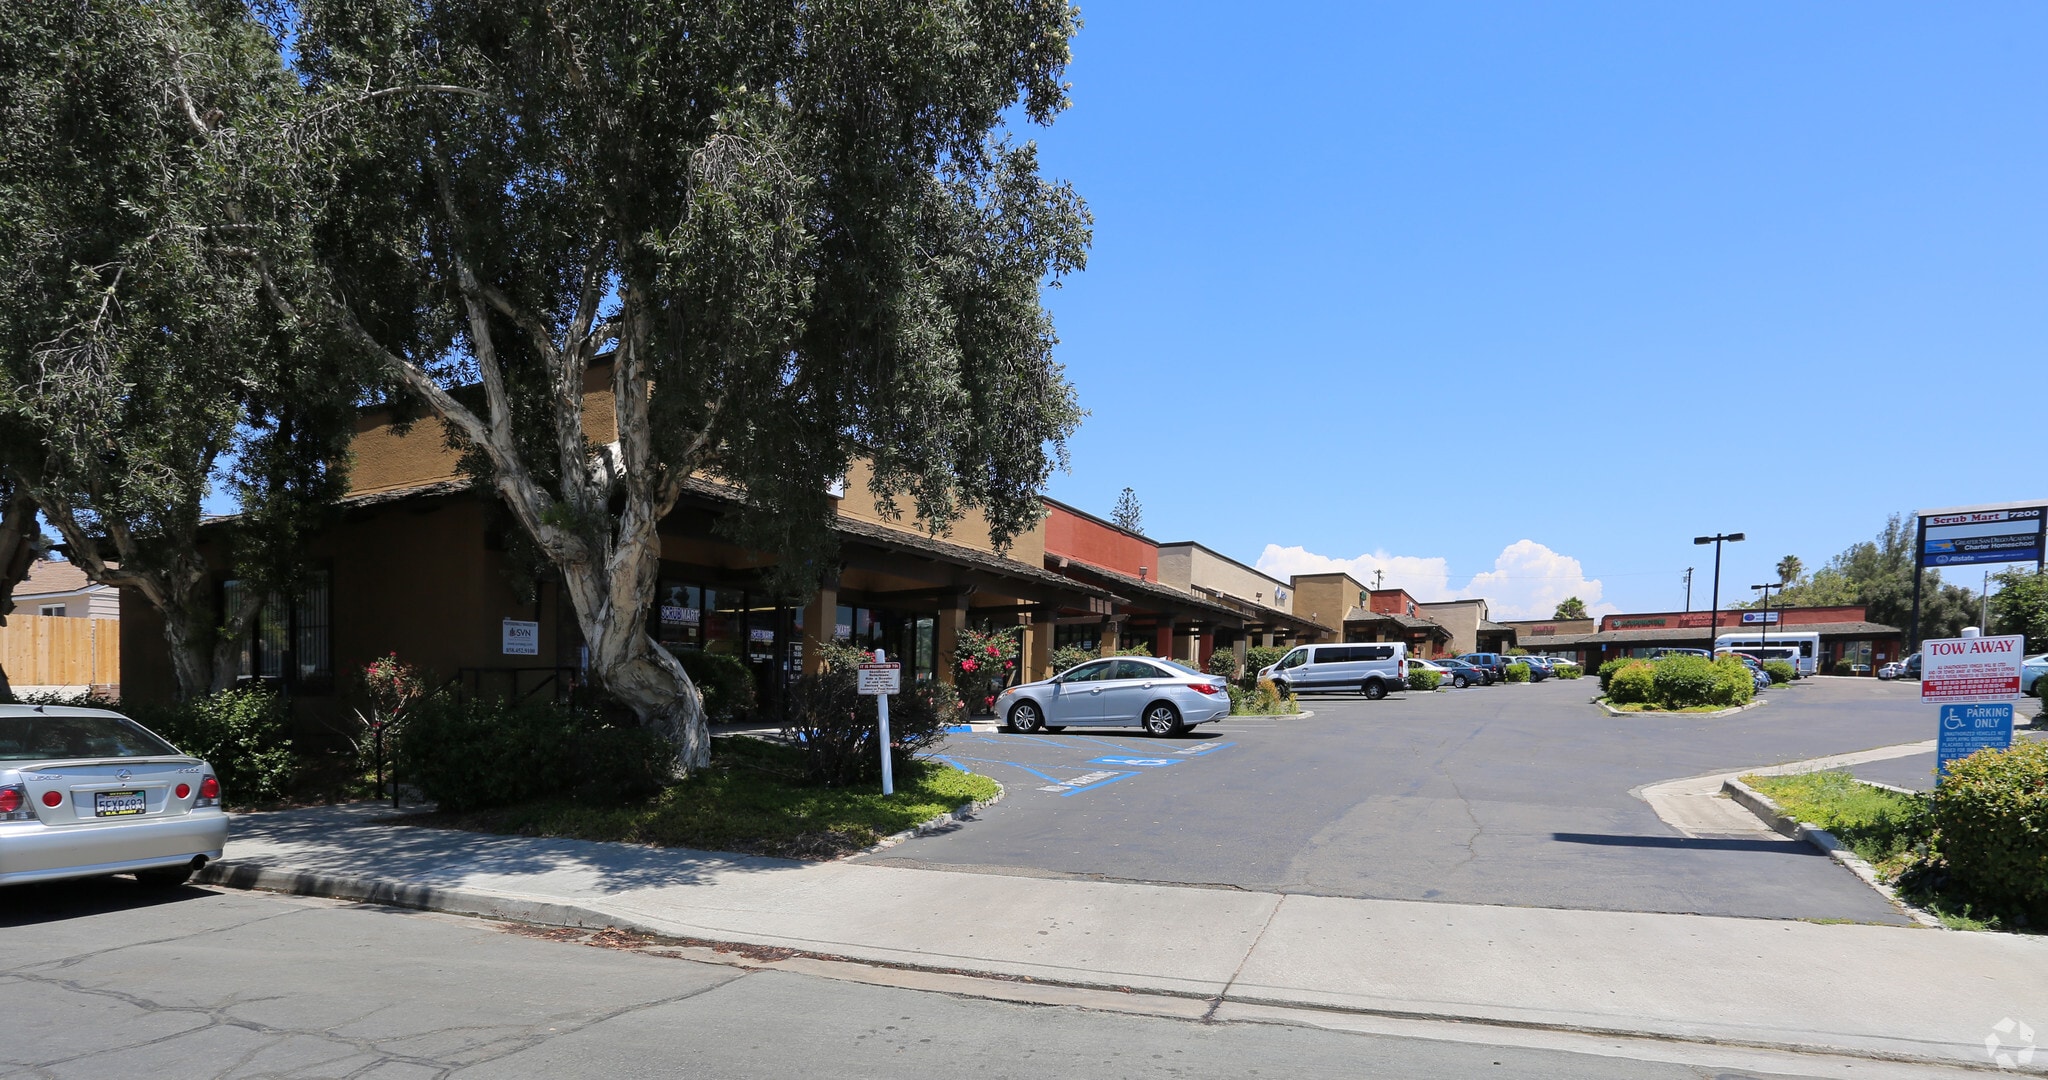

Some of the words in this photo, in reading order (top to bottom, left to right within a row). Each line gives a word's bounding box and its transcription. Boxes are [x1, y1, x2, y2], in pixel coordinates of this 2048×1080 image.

[1933, 516, 1967, 524] Scrub
[1971, 513, 2000, 522] Mart
[1931, 642, 1966, 656] TOW
[1970, 640, 2015, 654] AWAY
[1966, 708, 2009, 717] PARKING
[1975, 718, 2000, 728] ONLY
